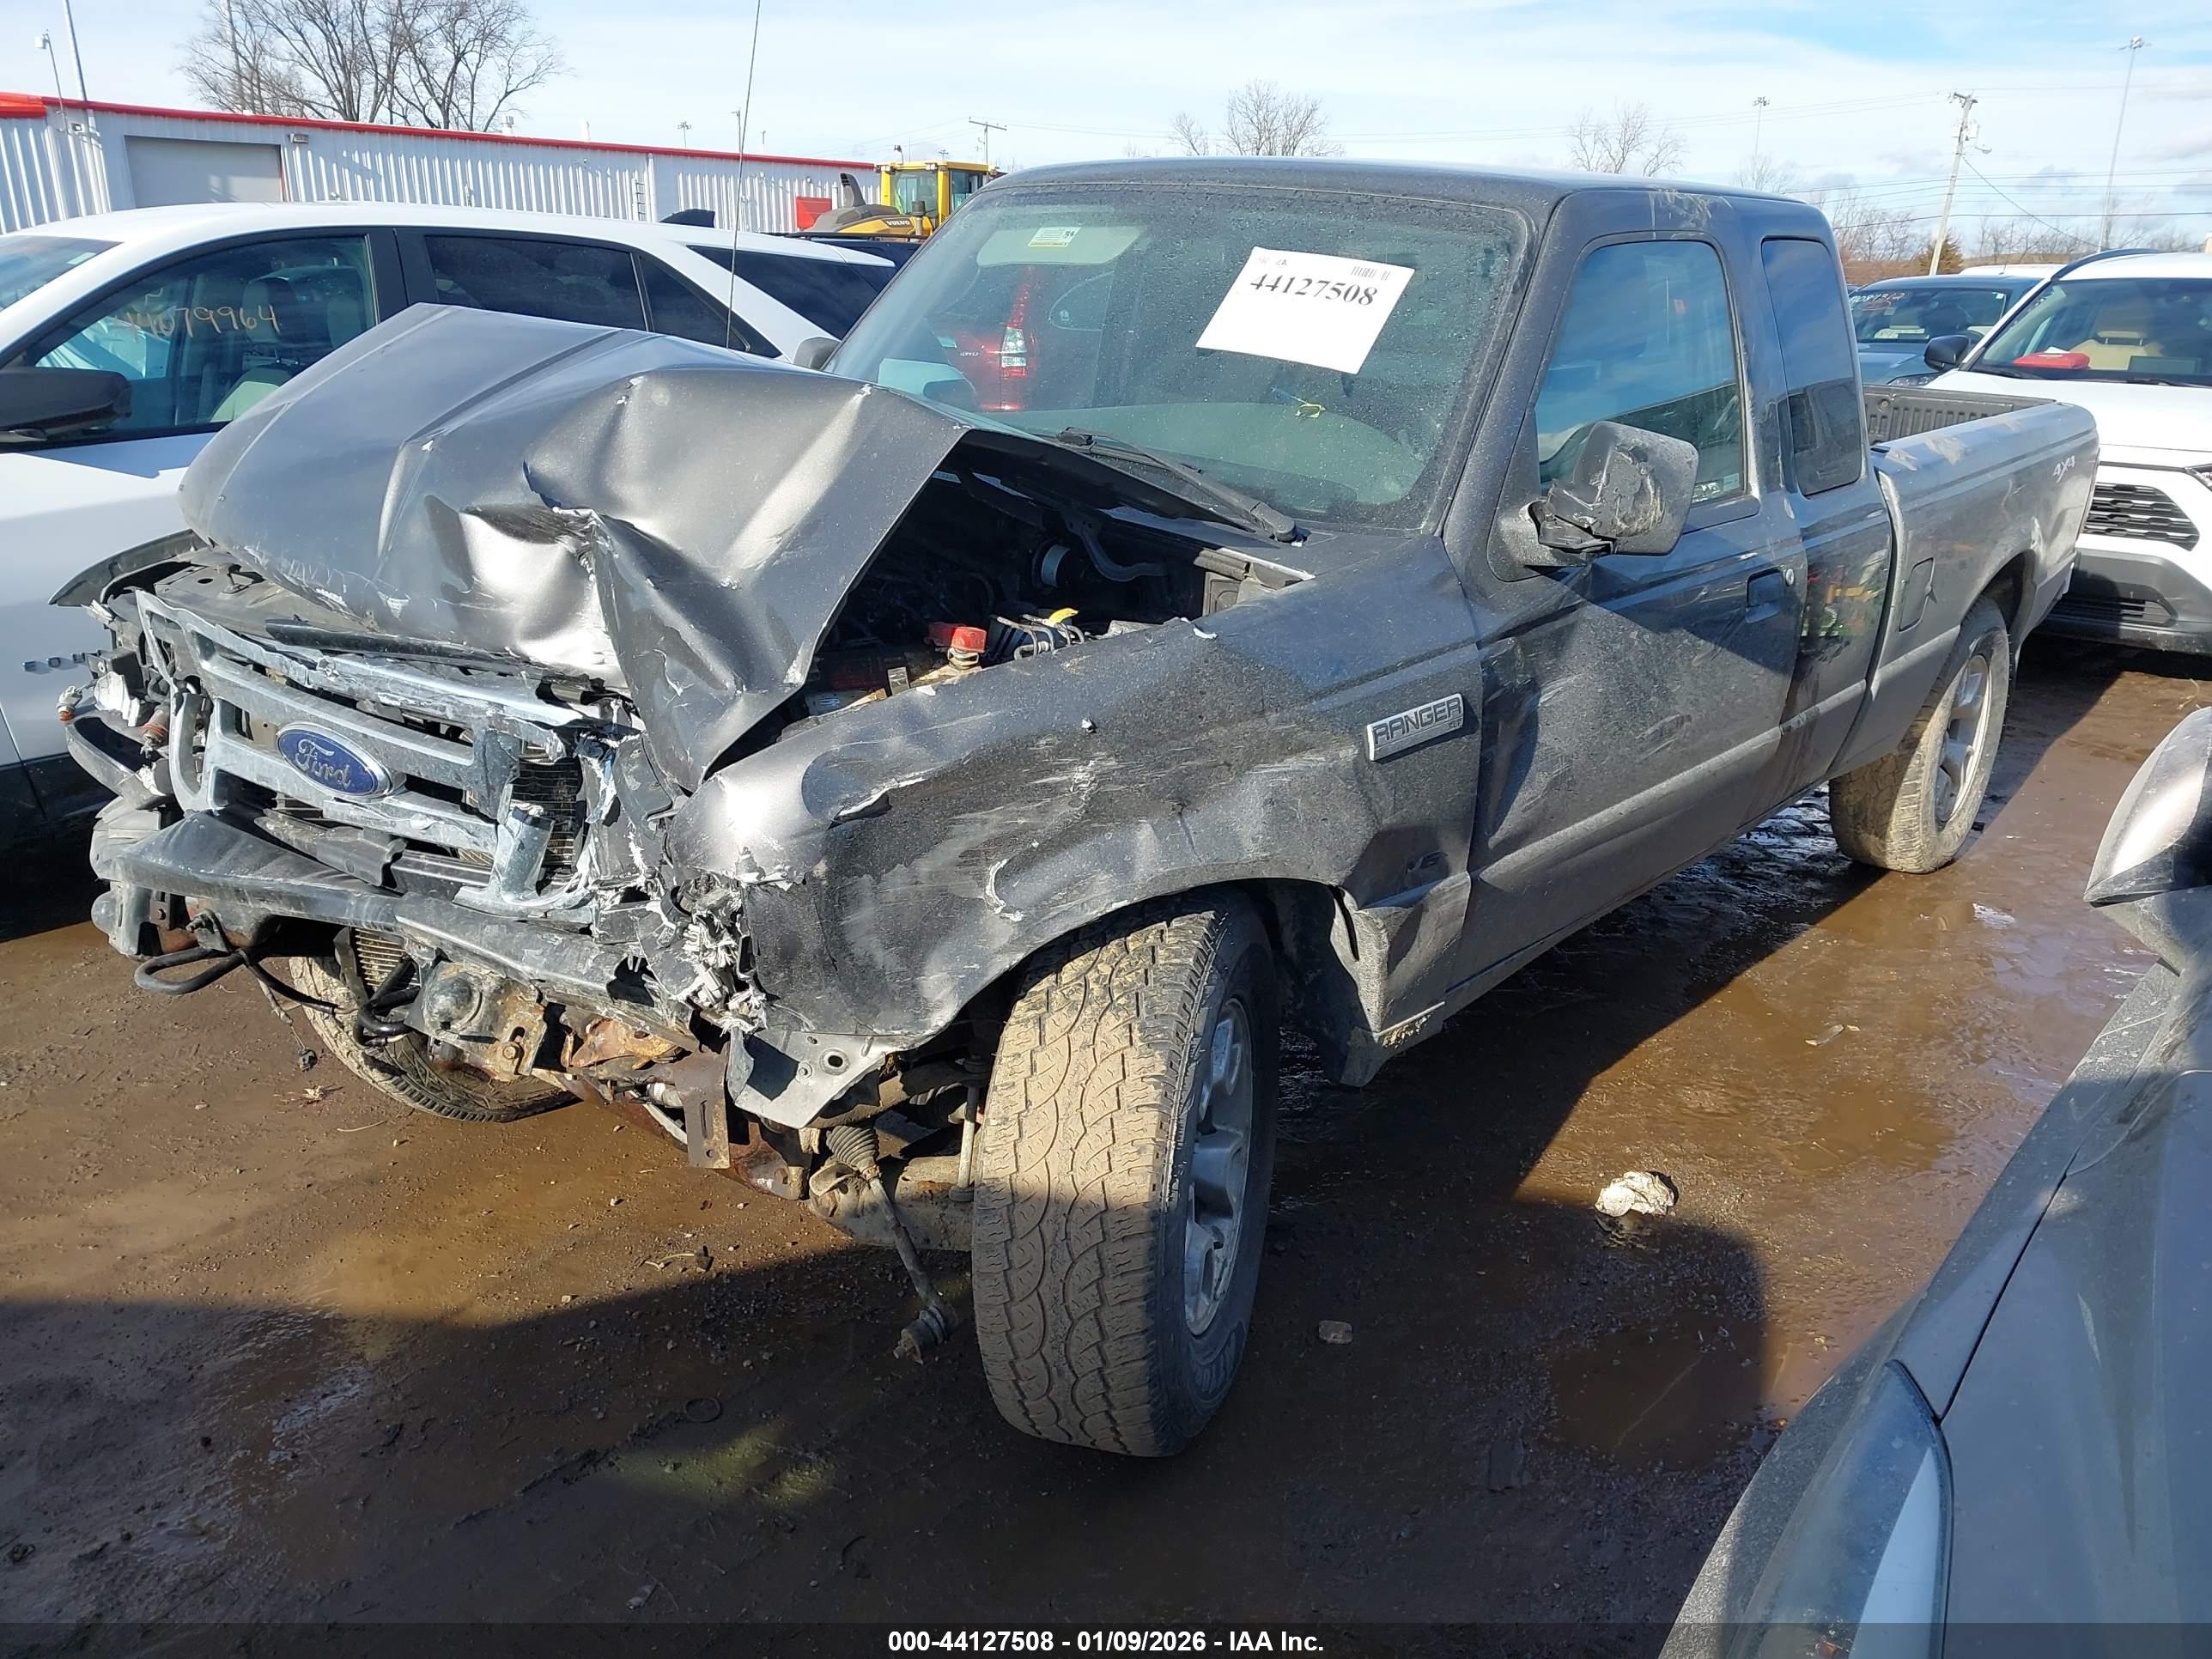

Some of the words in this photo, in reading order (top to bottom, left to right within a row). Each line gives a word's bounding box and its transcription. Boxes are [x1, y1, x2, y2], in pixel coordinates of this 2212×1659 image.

[1250, 273, 1378, 307] 44127508
[1373, 696, 1462, 745] RANGER
[295, 738, 352, 789] Ford
